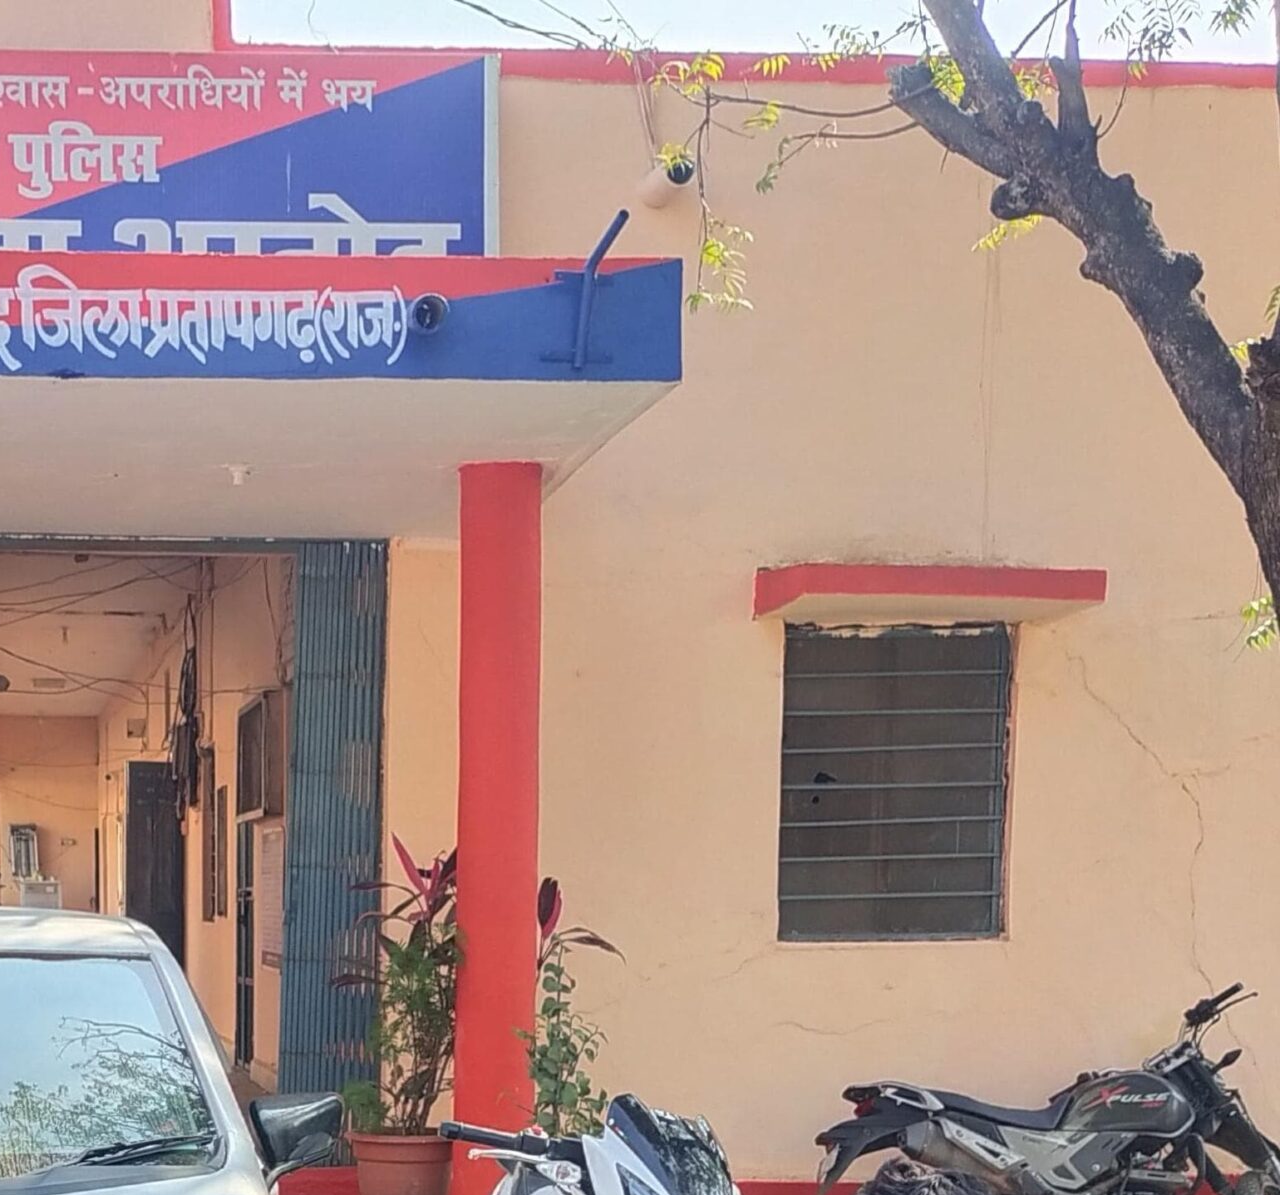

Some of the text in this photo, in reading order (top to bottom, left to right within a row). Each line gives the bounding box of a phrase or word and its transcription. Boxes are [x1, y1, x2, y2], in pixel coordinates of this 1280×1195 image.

[99, 64, 265, 112] अपराधियों
[277, 67, 308, 112] में
[321, 79, 377, 113] भय
[7, 120, 163, 200] पुलिस
